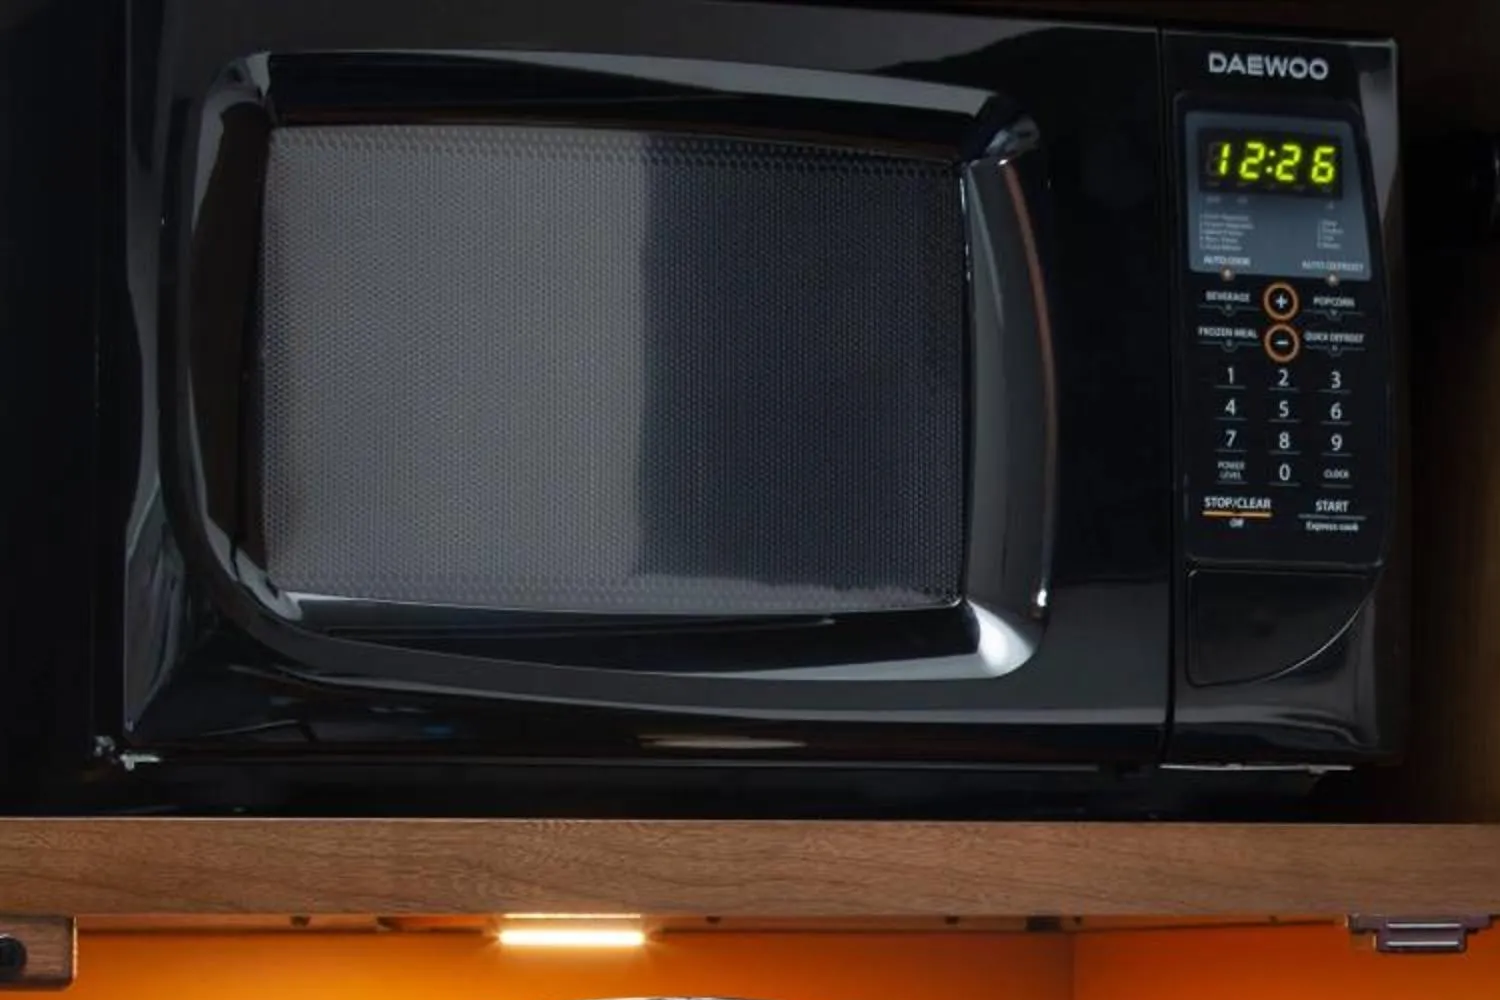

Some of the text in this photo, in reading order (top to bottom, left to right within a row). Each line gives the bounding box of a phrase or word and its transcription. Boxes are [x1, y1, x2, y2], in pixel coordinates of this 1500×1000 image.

[1207, 53, 1329, 80] DAEWOO
[1217, 142, 1336, 183] 12:26
[1312, 295, 1355, 308] POPCORN
[1226, 366, 1235, 384] 1
[1279, 368, 1288, 387] 2
[1331, 370, 1342, 390] 3
[1225, 398, 1236, 415] 4
[1279, 400, 1289, 418] 5
[1331, 402, 1343, 421] 6
[1226, 430, 1237, 447] 7
[1279, 431, 1291, 450] 8
[1331, 433, 1343, 452] 9
[1278, 462, 1291, 482] 0
[1322, 468, 1351, 480] CLOCK
[1203, 495, 1272, 510] STOP/CLEAR
[1315, 499, 1350, 513] START
